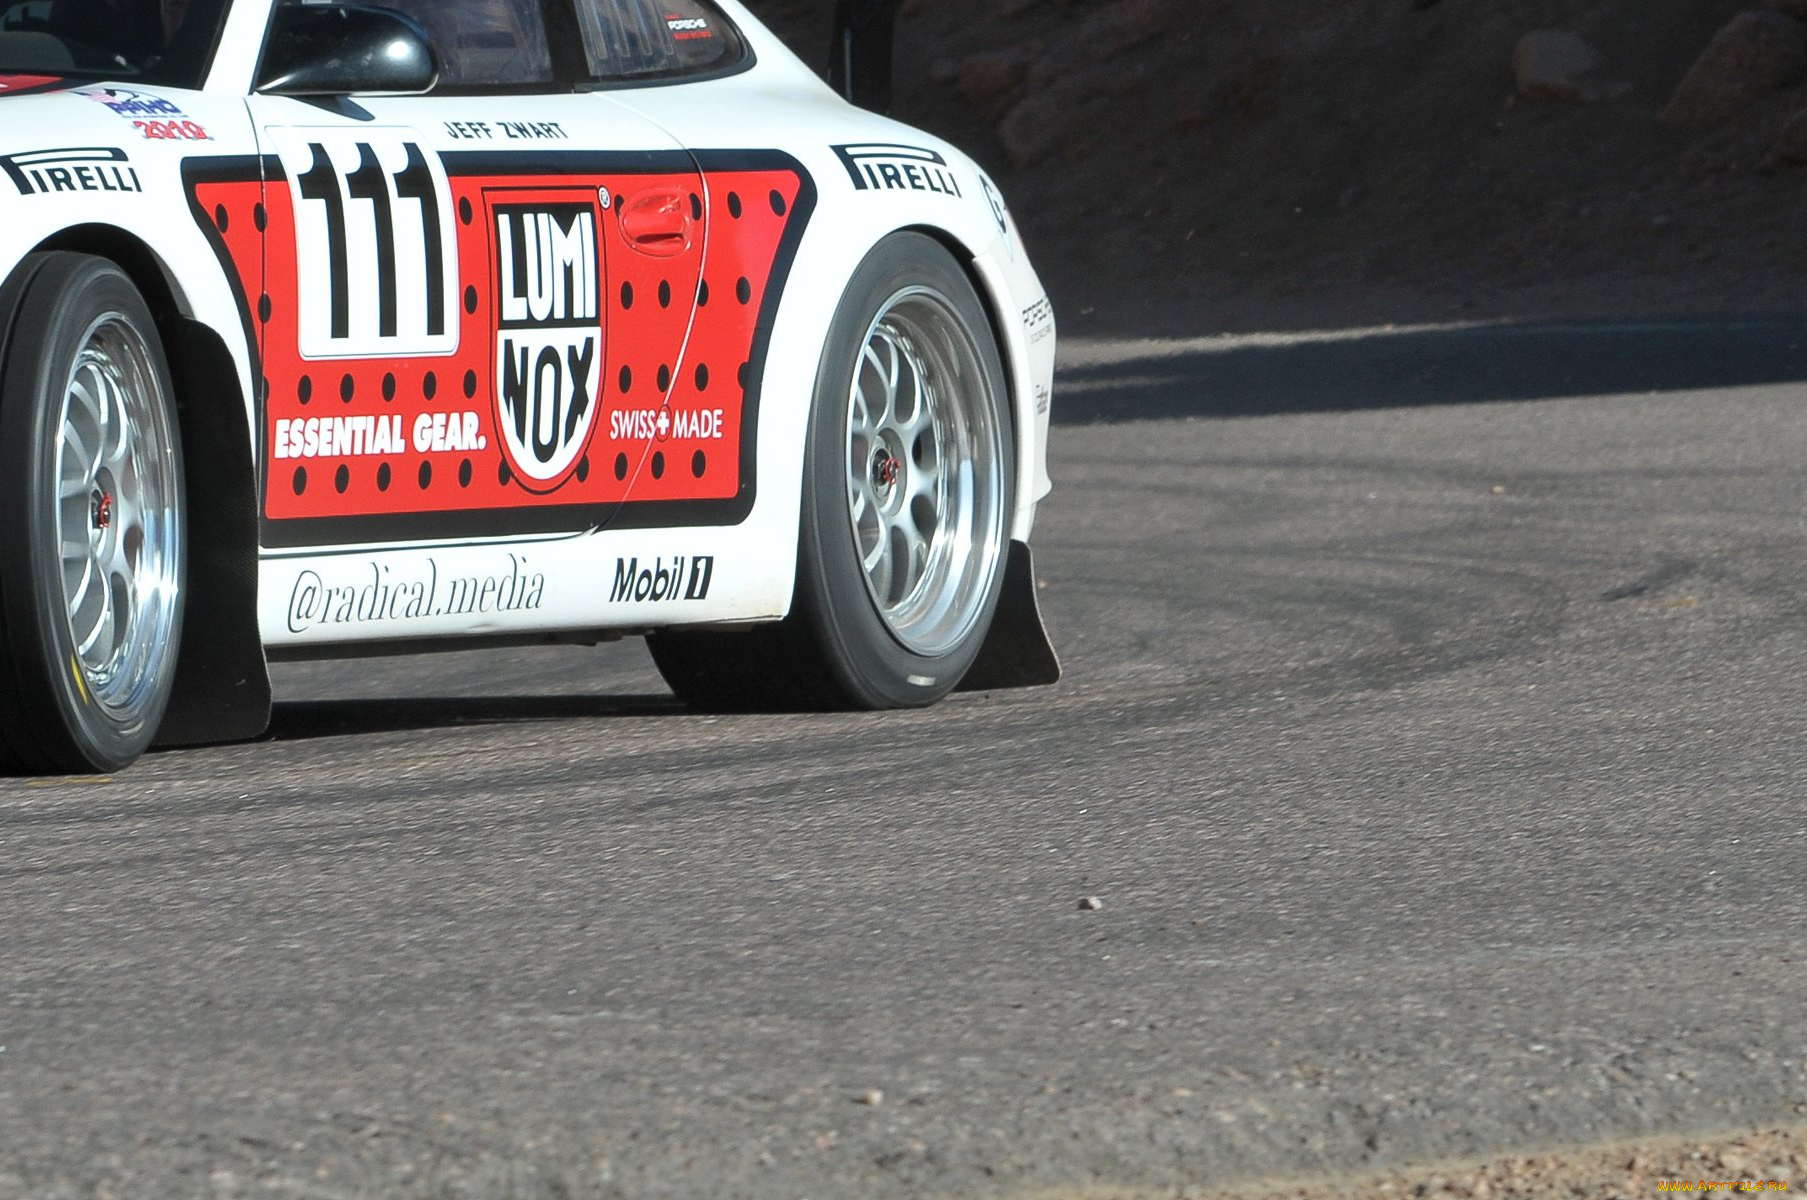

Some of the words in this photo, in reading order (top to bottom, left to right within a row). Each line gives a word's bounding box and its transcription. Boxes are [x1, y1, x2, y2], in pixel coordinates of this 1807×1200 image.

[132, 120, 208, 139] 2010
[446, 122, 493, 140] JEFF
[496, 122, 568, 140] ZWART
[830, 143, 963, 199] PIRELLI
[297, 142, 445, 339] 111
[497, 211, 596, 321] LUMI
[503, 336, 595, 464] NOX
[610, 411, 656, 440] SWISS
[673, 408, 722, 439] MADE
[274, 414, 405, 459] ESSENTIAL
[413, 412, 486, 453] GEAR.
[288, 553, 545, 633] @radical.media
[609, 557, 684, 603] Mobil
